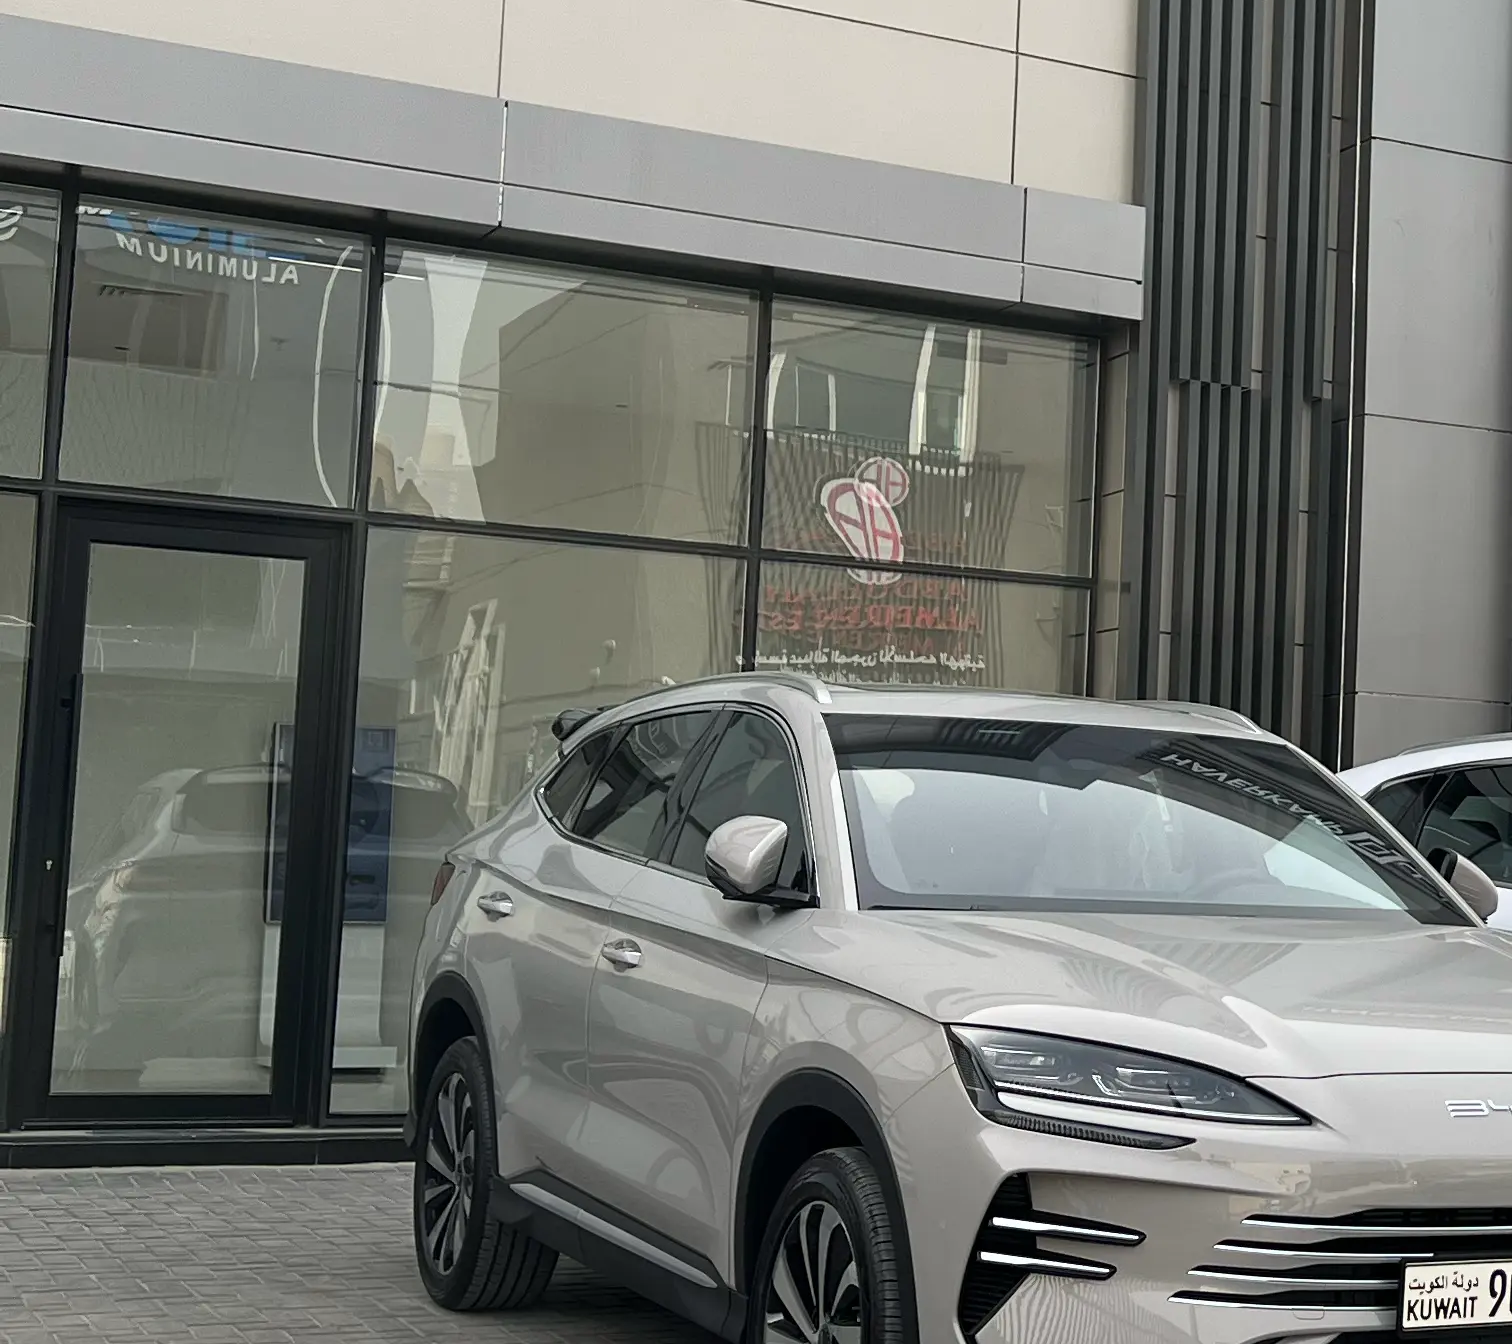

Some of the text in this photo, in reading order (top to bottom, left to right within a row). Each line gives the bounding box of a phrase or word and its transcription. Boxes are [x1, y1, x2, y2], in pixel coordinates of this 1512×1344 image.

[1408, 1270, 1479, 1296] دولة الكويت
[1406, 1296, 1478, 1322] KUWAIT
